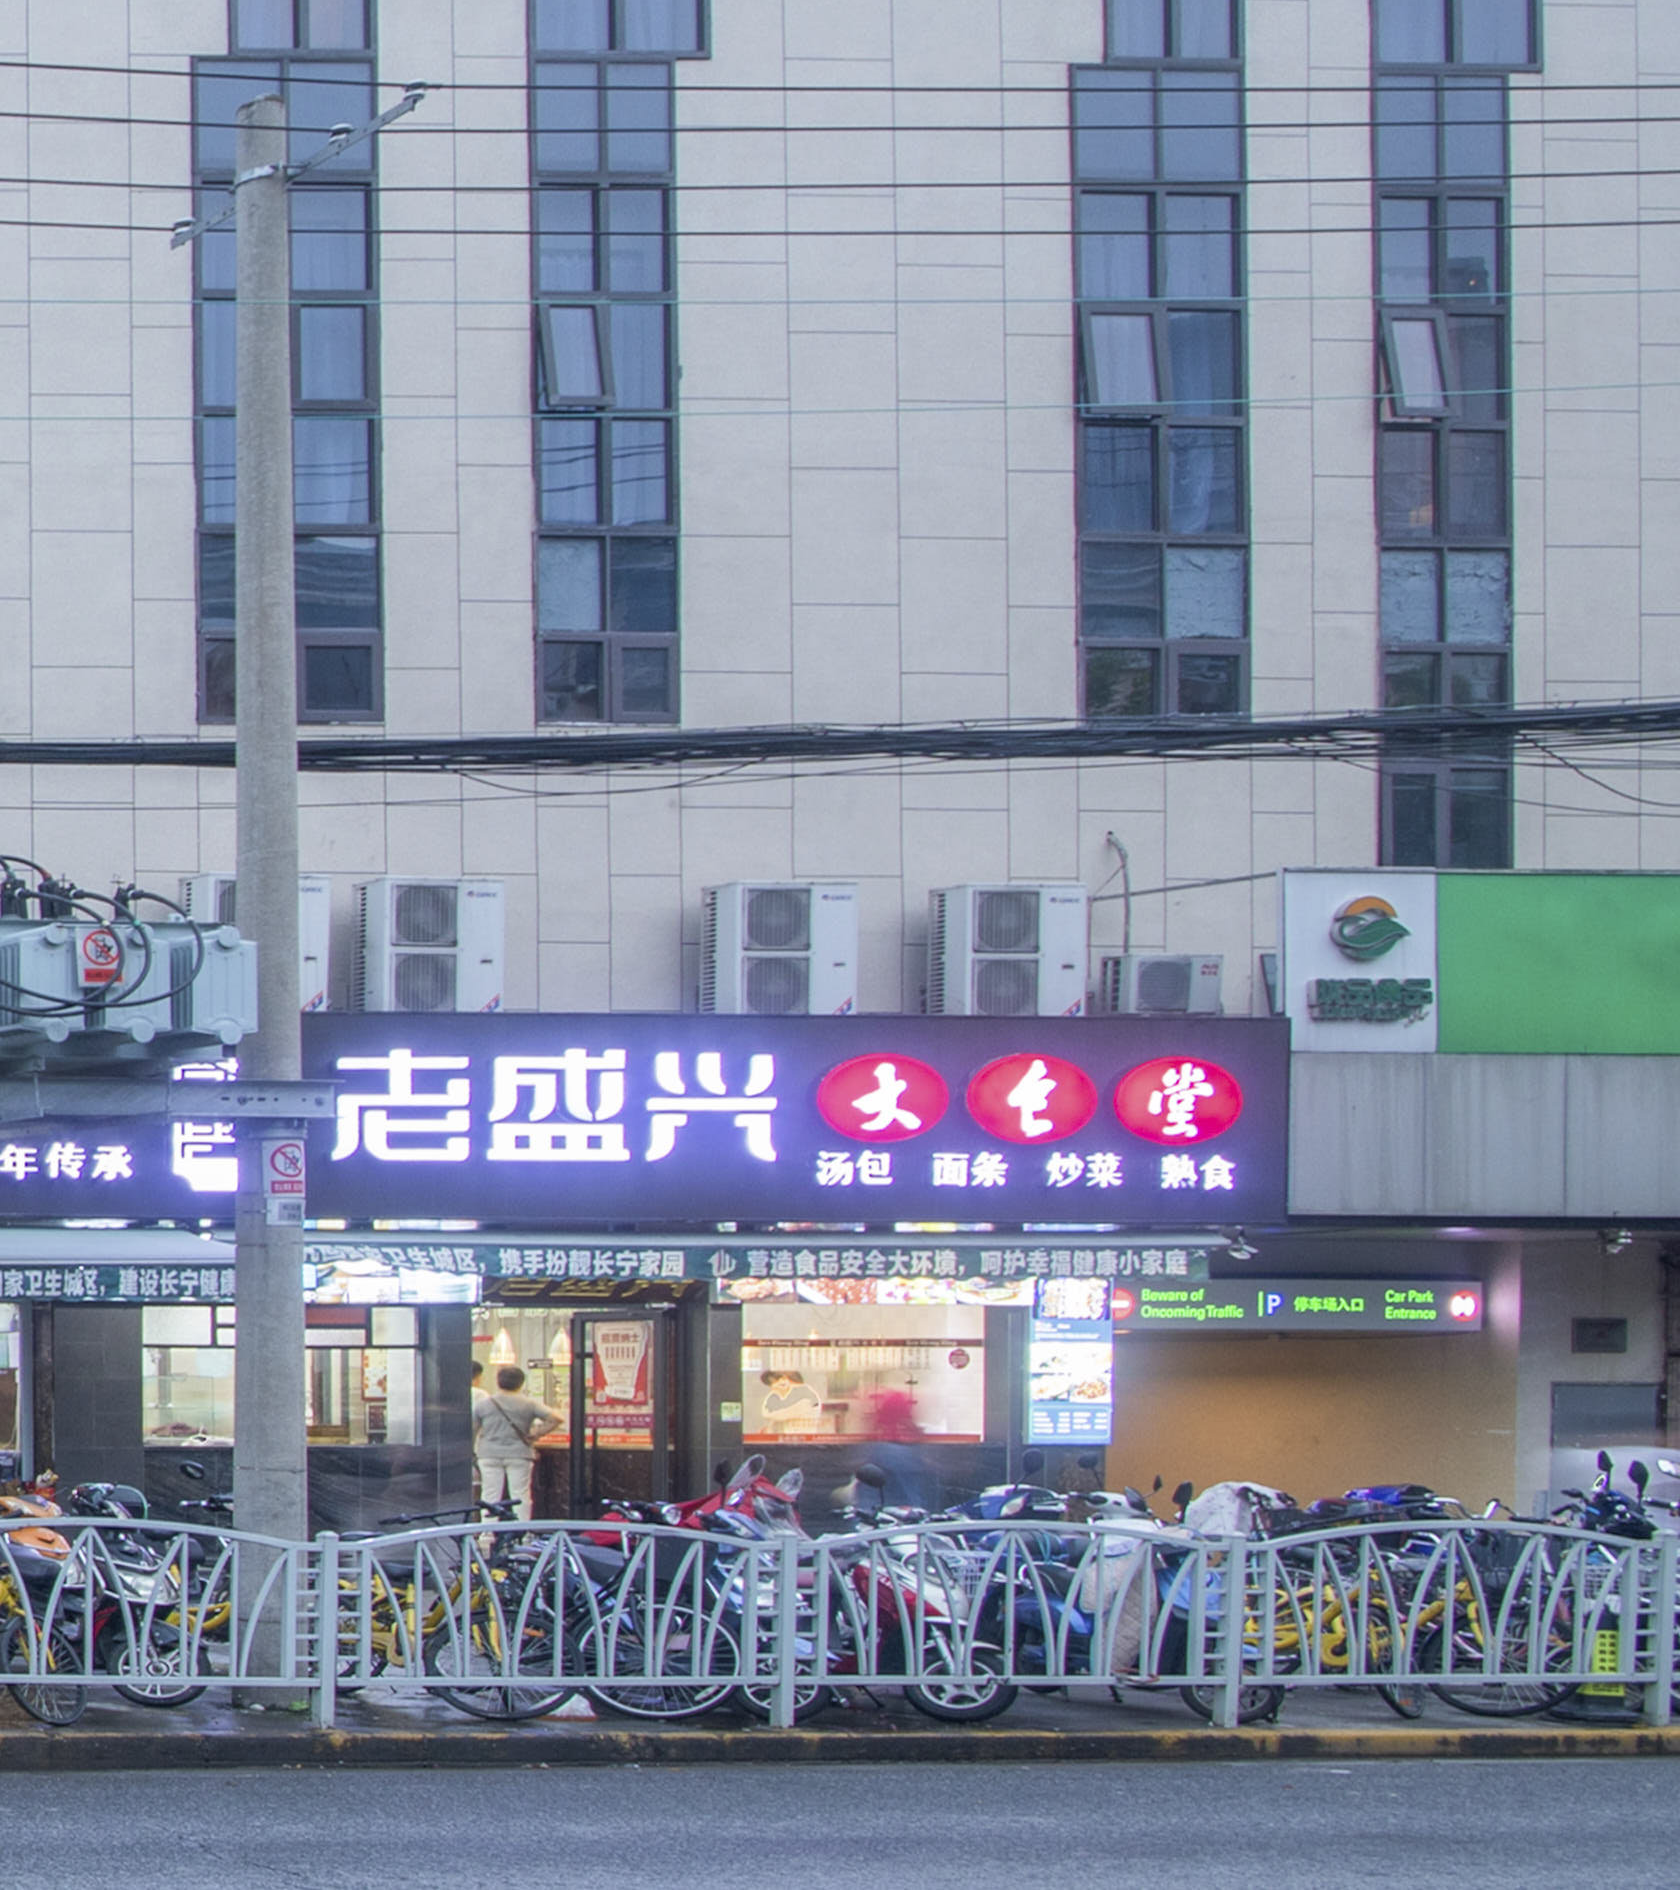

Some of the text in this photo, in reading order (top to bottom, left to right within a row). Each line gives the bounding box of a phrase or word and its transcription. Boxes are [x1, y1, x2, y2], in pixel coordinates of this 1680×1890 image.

[331, 1048, 778, 1163] 老盛兴
[816, 1150, 1237, 1191] 汤包 面条 炒菜 熟食
[1141, 1289, 1205, 1302] Beware of
[1385, 1289, 1434, 1303] Car Park
[1293, 1296, 1365, 1313] 停车场入口
[1385, 1306, 1437, 1320] Entrance
